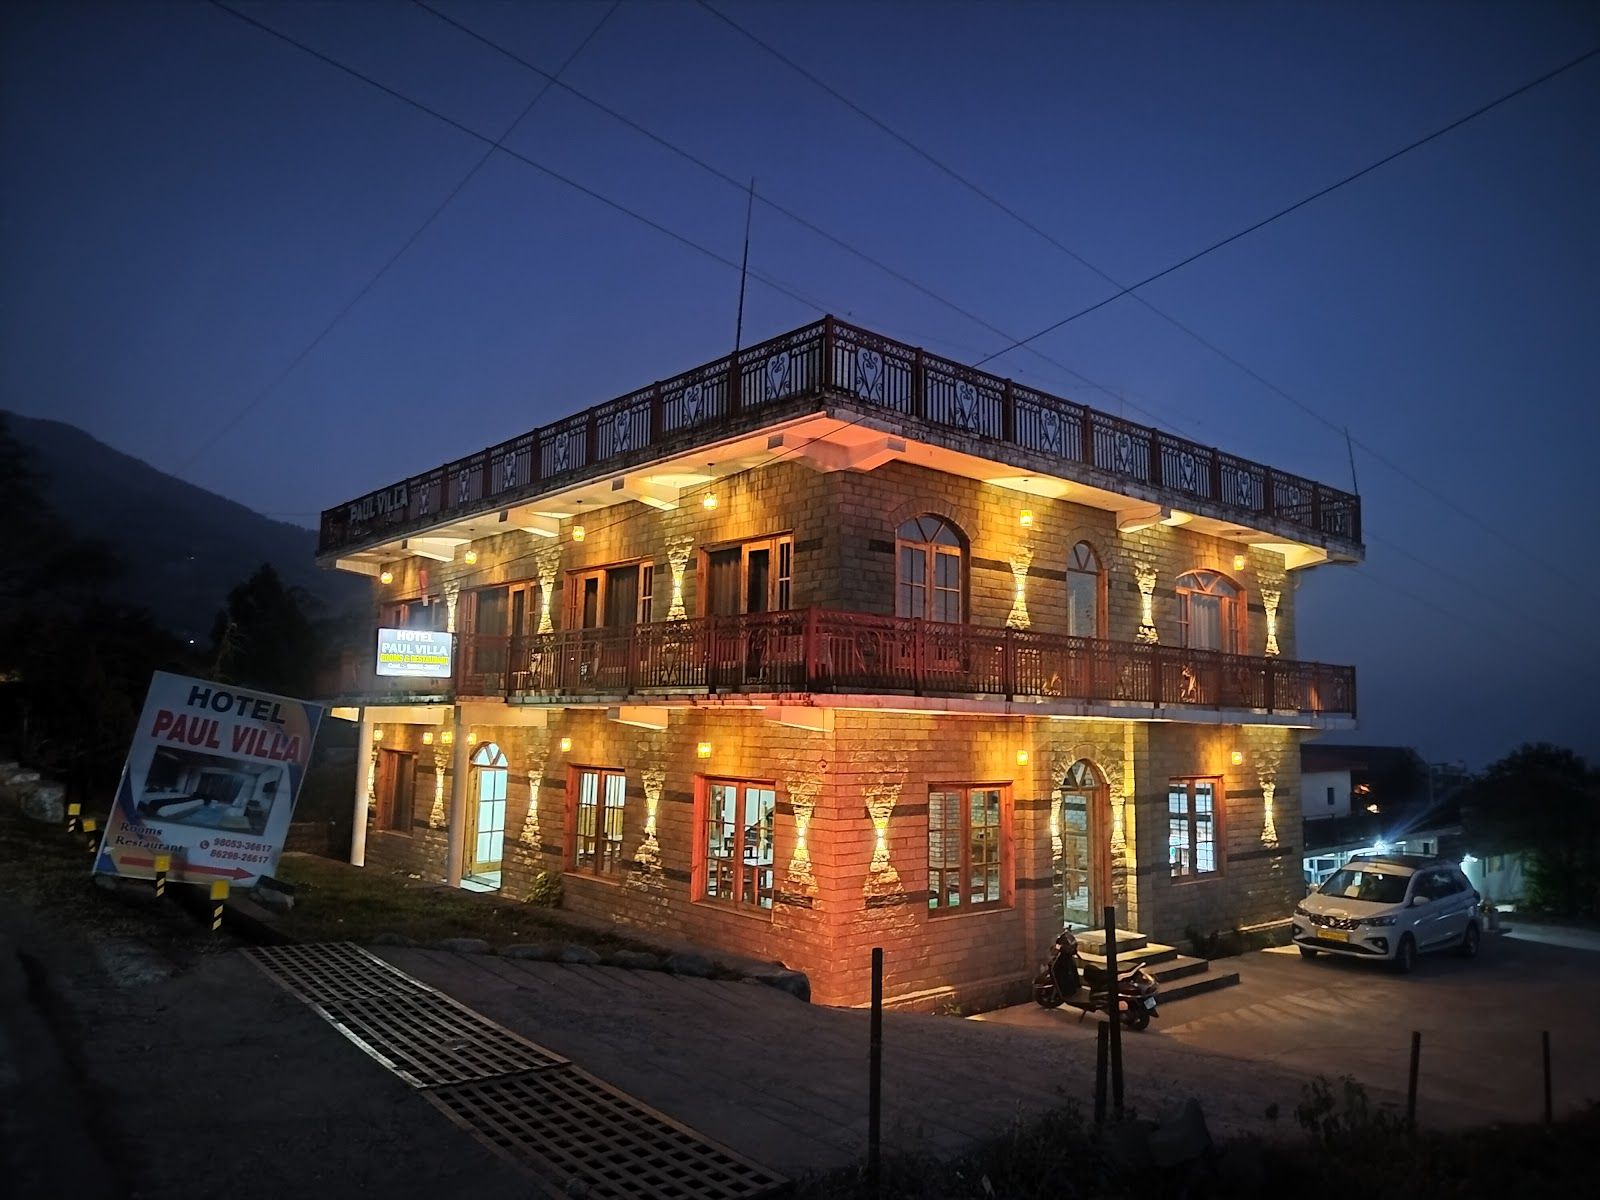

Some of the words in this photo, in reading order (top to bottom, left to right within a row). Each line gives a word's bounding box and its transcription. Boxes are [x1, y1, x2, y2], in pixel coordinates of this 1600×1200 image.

[350, 499, 375, 524] PAUL
[377, 484, 409, 514] VILLA
[397, 631, 434, 643] HOTEL
[382, 642, 413, 654] PAUL
[414, 644, 448, 656] VILLA
[186, 685, 286, 724] HOTEL
[151, 709, 221, 749] PAUL
[231, 724, 302, 762] VILLA
[119, 821, 163, 836] Rooms
[114, 835, 186, 852] Restaurant
